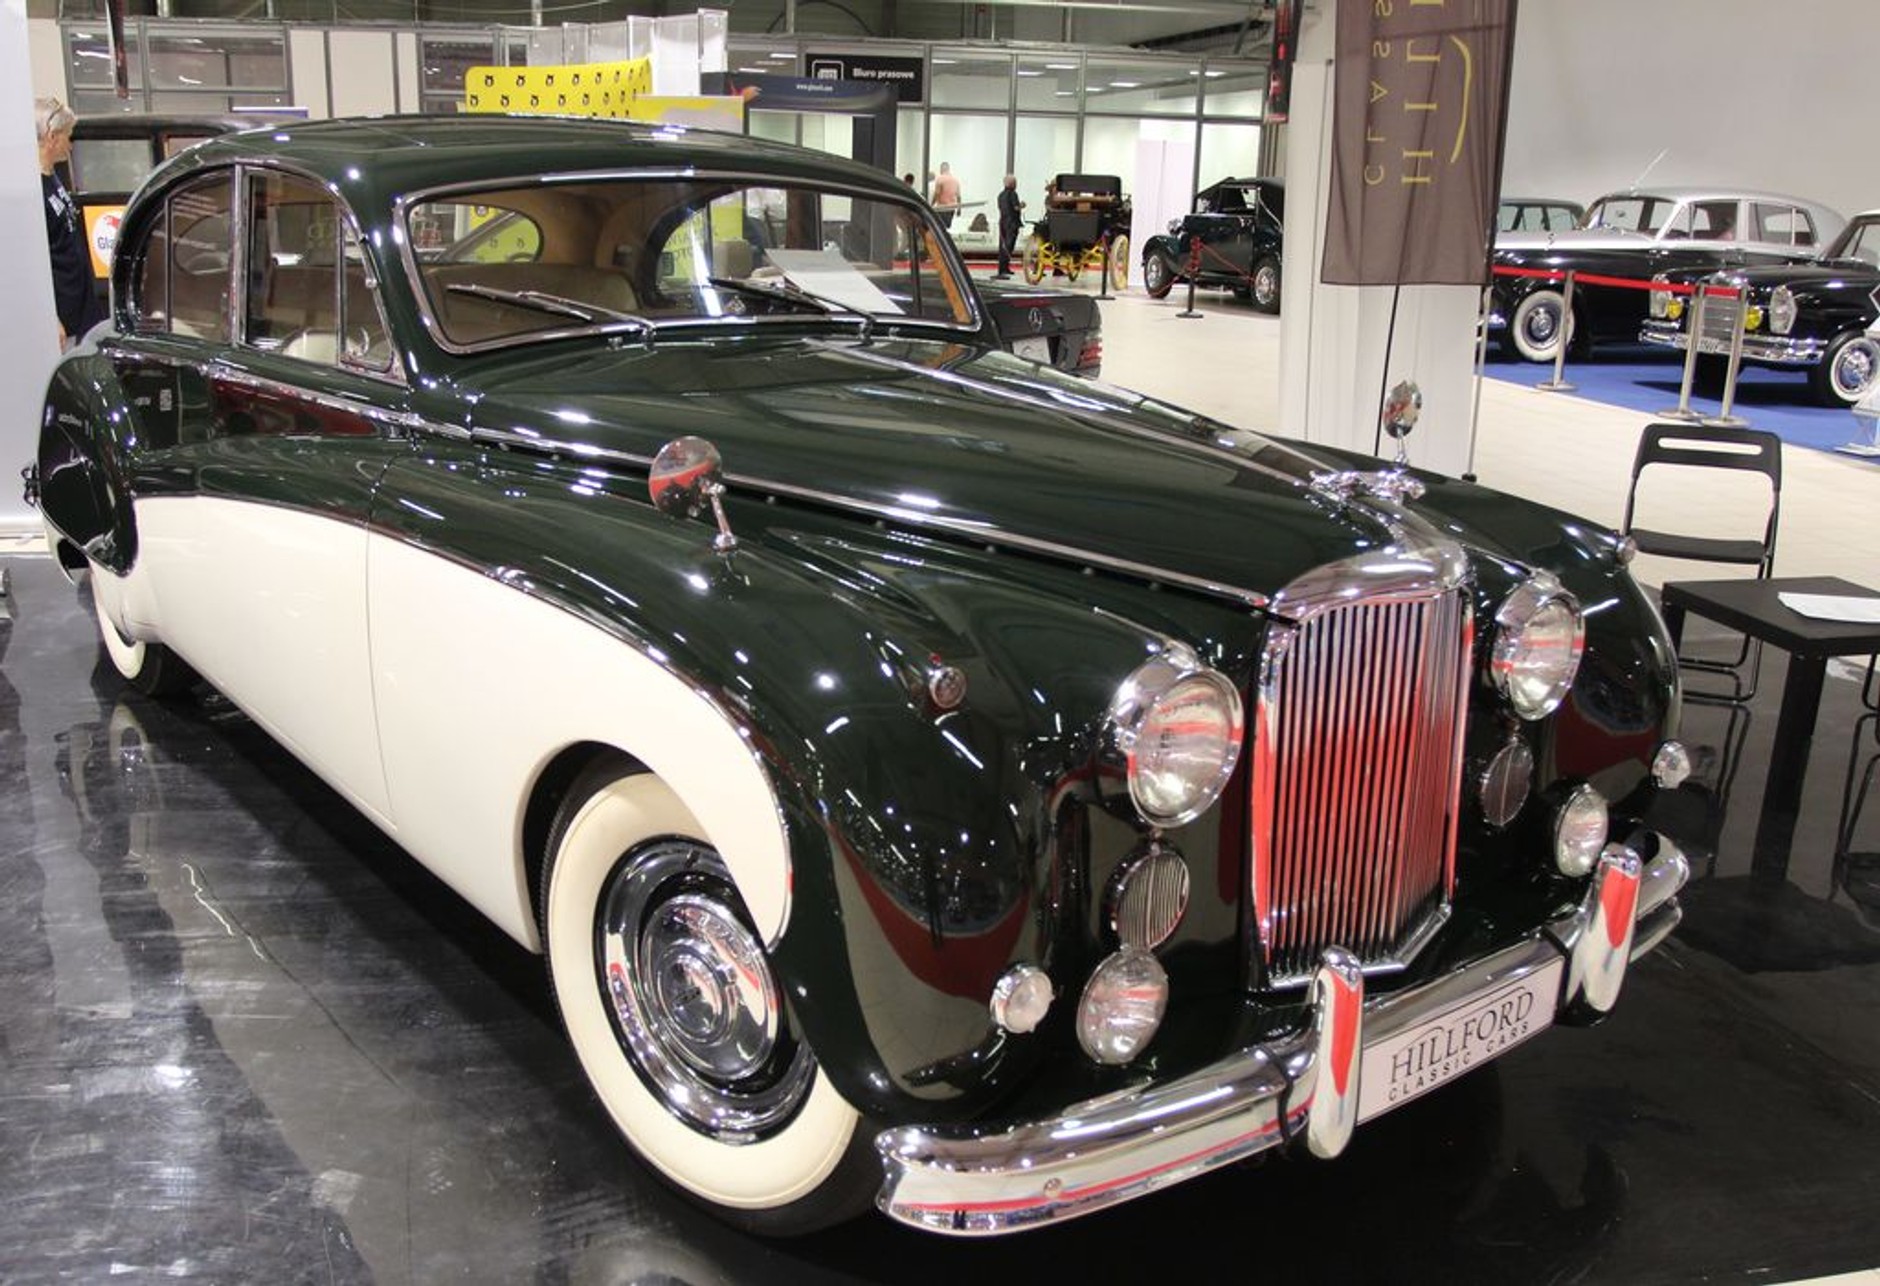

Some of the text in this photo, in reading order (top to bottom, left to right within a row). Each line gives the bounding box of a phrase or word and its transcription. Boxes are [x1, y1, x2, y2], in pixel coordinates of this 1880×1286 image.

[852, 67, 915, 80] Biuro prasowe
[1388, 1021, 1529, 1101] CLASSIC CARS
[1391, 991, 1534, 1083] HILLFORD
